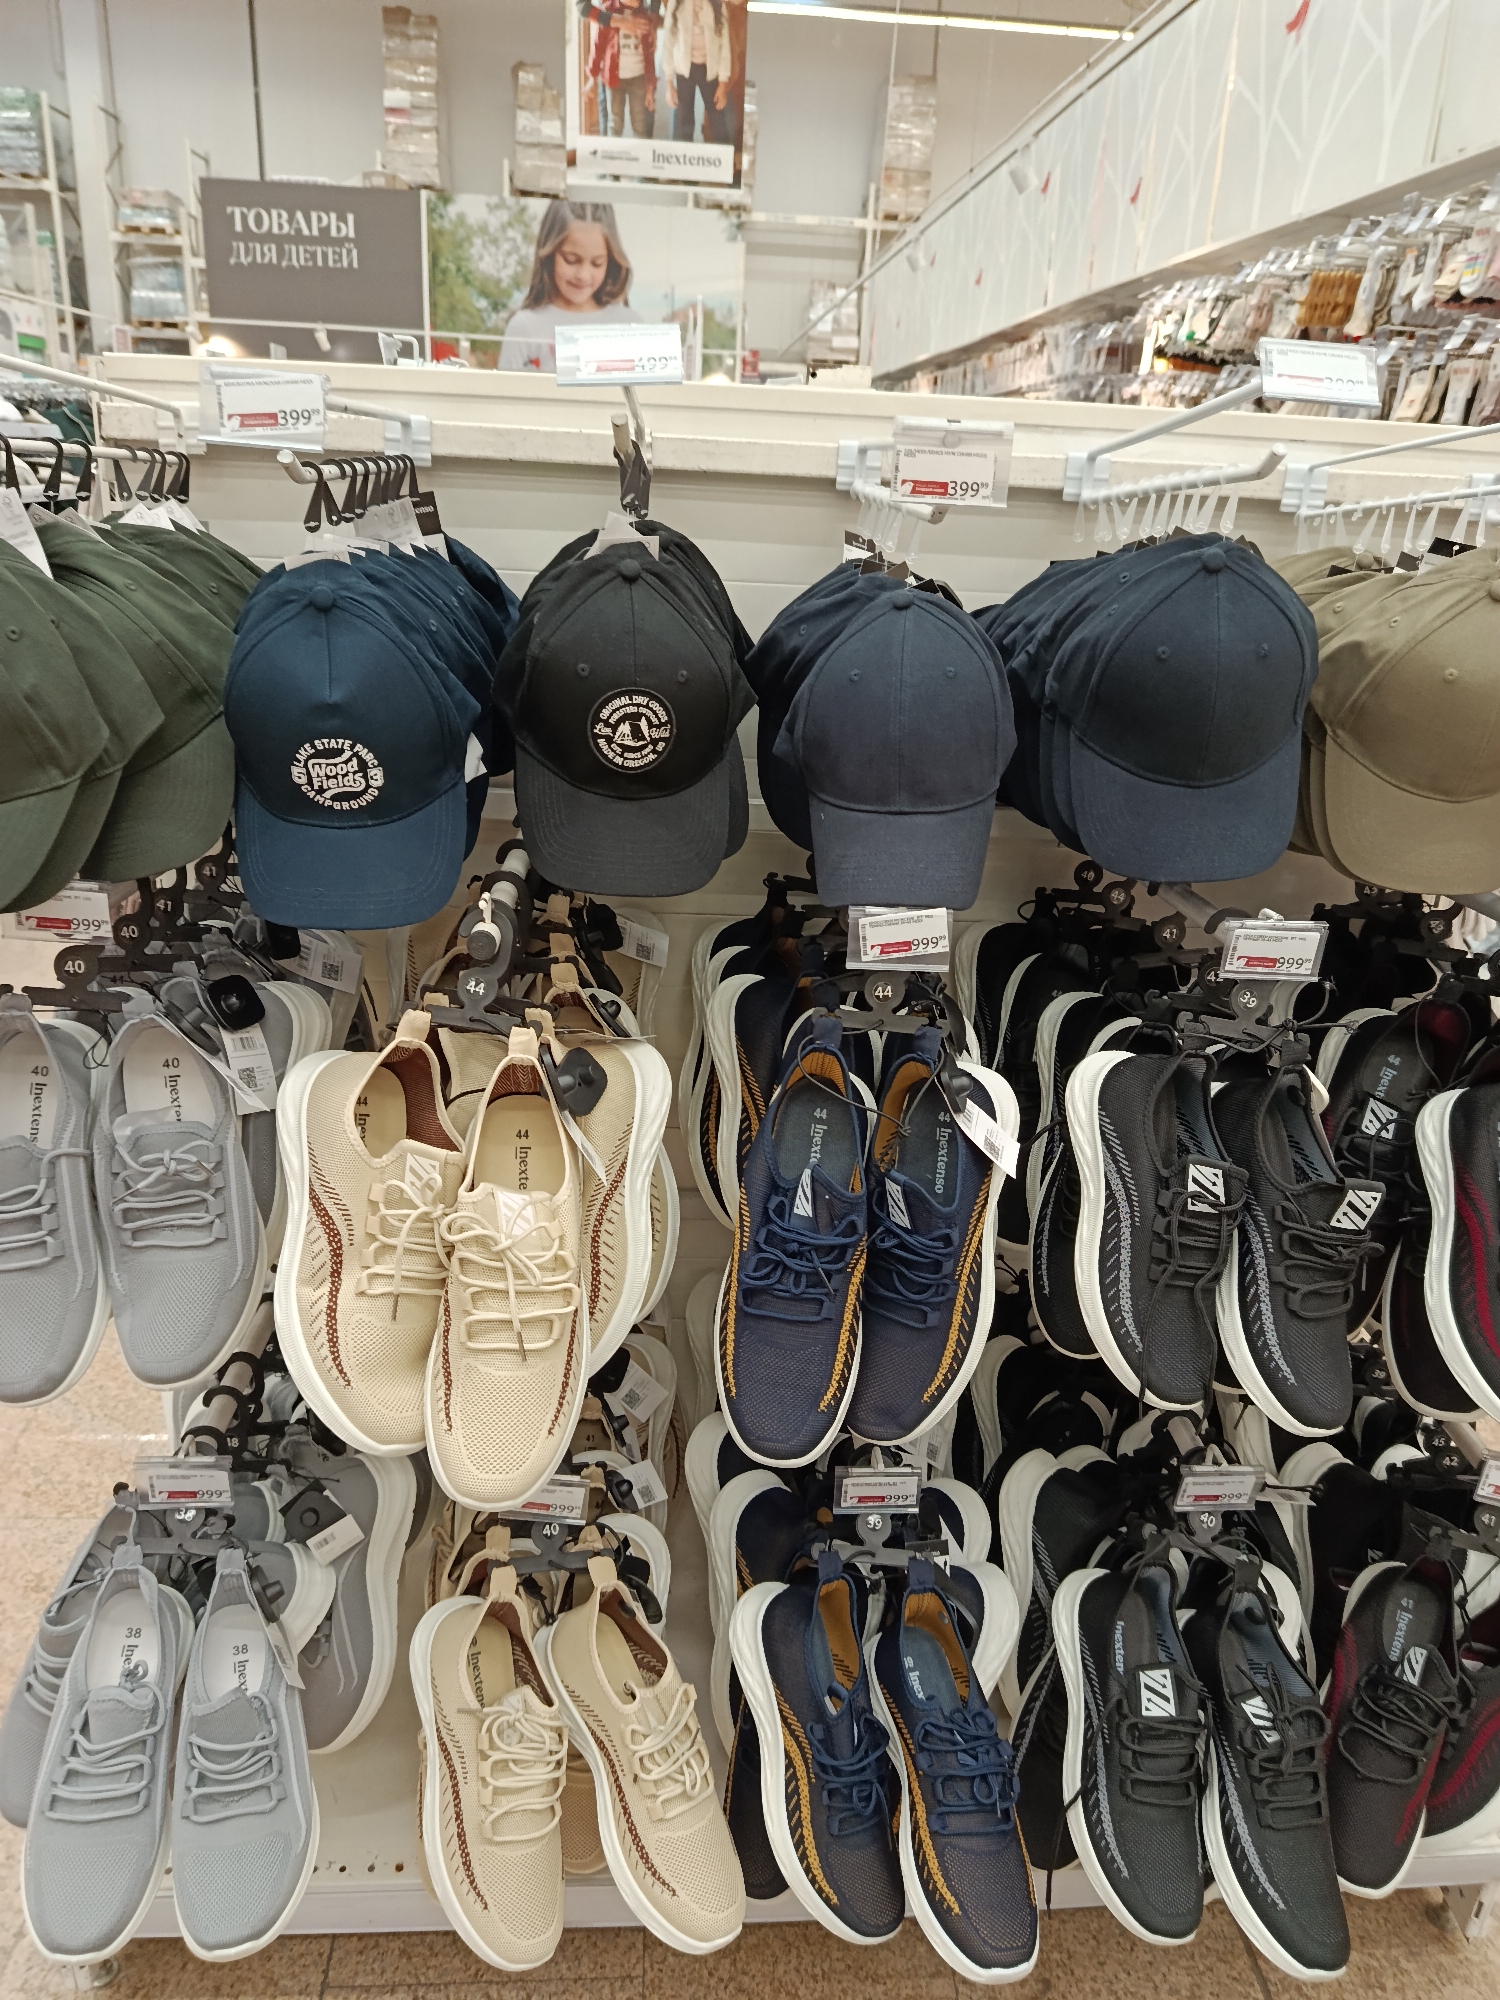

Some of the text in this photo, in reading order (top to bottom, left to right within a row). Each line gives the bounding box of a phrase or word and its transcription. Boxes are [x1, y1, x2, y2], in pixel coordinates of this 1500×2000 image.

[652, 148, 722, 169] Inextenso
[226, 205, 356, 239] ТОВАРЫ
[228, 240, 359, 269] ДЛЯ ДЕТЕЙ
[277, 408, 312, 427] 399
[947, 480, 980, 498] 399
[600, 695, 668, 723] ORIGINAL DRY GOODS
[293, 738, 379, 768] LAKE STATE PARC
[597, 738, 617, 760] MADE
[311, 756, 359, 778] Wood
[312, 772, 367, 790] Fields
[300, 784, 379, 811] CAMPGROUND
[202, 866, 217, 878] 41
[1110, 890, 1126, 903] 44
[155, 898, 173, 913] 41
[70, 917, 101, 932] 999
[120, 925, 139, 939] 40
[1162, 928, 1178, 939] 41
[911, 936, 940, 951] 999
[63, 959, 86, 974] 40
[1276, 956, 1304, 970] 999
[466, 979, 486, 996] 44
[874, 985, 894, 999] 44
[1239, 991, 1258, 1008] 39
[162, 1057, 181, 1069] 40
[1387, 1053, 1402, 1067] 44
[30, 1064, 50, 1078] 40
[813, 1107, 828, 1120] 44
[515, 1128, 532, 1191] 44 Inexte
[934, 1111, 953, 1194] 44 Inextenso
[585, 1434, 595, 1443] 41
[1431, 1437, 1447, 1447] 45
[1442, 1456, 1459, 1467] 42
[197, 1489, 223, 1499] 999
[885, 1494, 909, 1503] 999
[1220, 1492, 1243, 1501] 999
[174, 1508, 197, 1522] 38
[550, 1503, 575, 1514] 999
[866, 1516, 883, 1530] 39
[1199, 1512, 1216, 1528] 40
[1481, 1513, 1497, 1527] 41
[542, 1522, 560, 1537] 40
[125, 1627, 142, 1639] 38
[232, 1643, 249, 1656] 38
